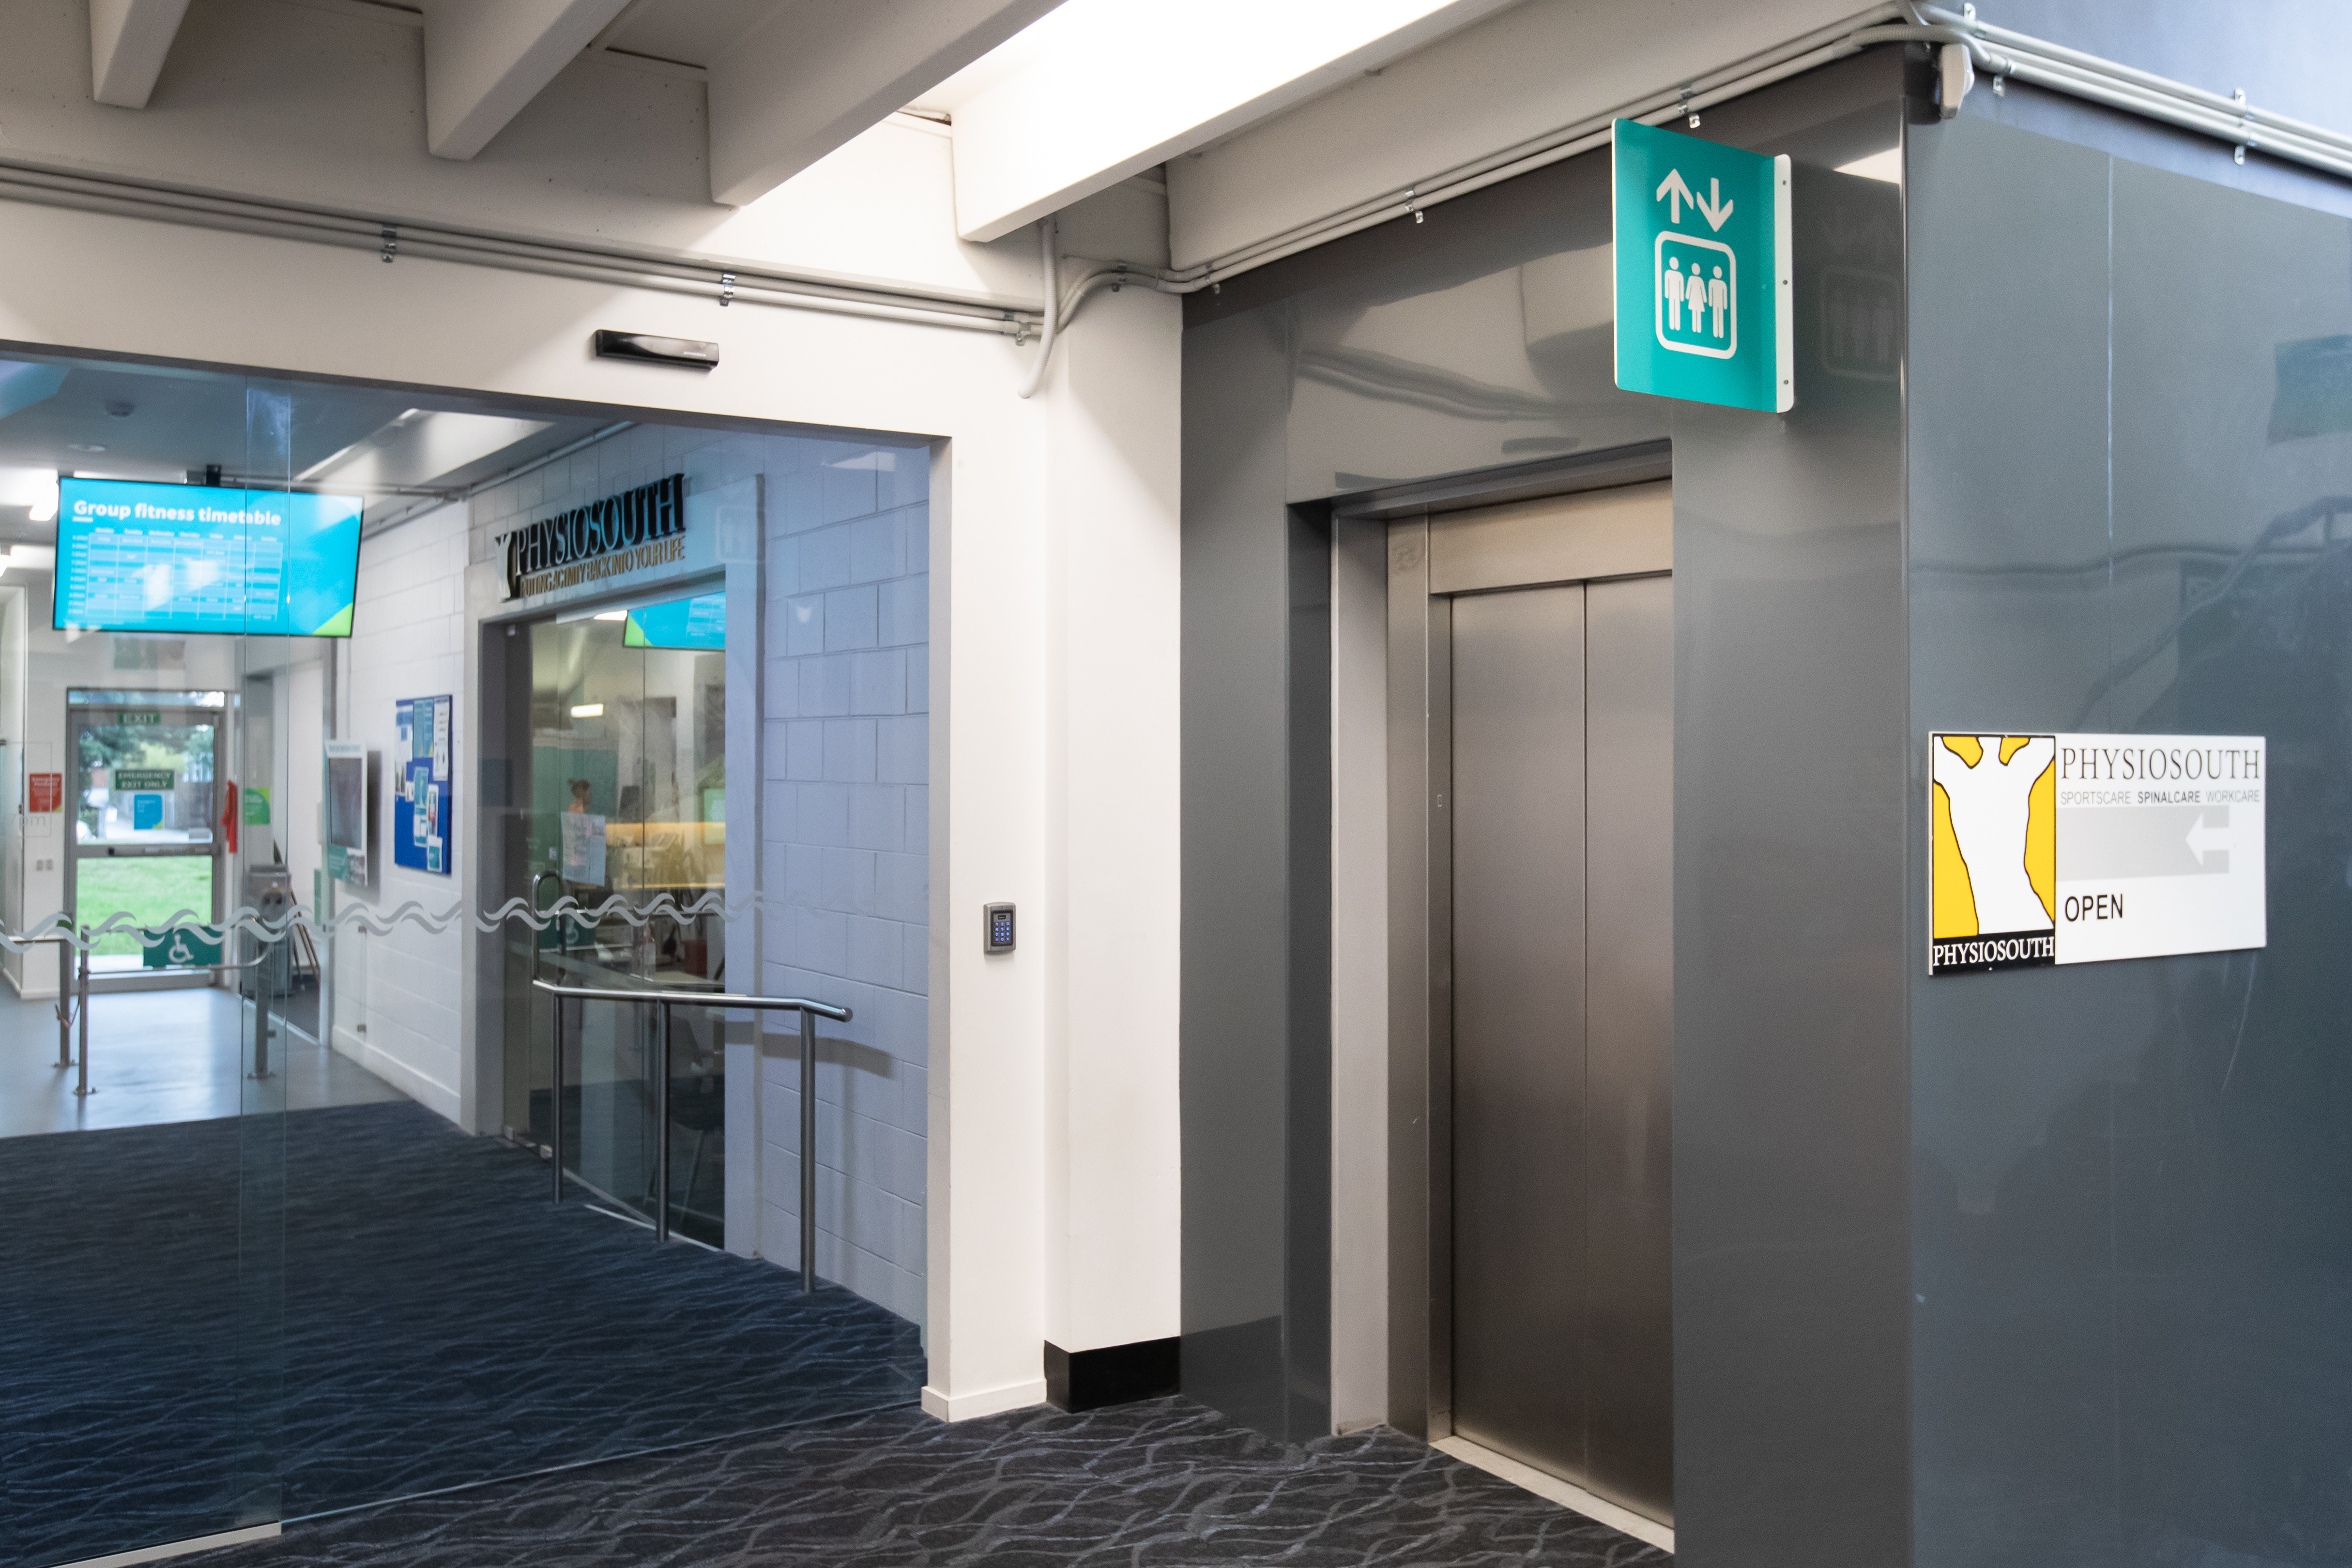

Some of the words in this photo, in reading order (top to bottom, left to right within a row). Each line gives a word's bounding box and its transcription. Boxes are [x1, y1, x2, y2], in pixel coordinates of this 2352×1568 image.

[74, 500, 131, 520] Group
[135, 502, 195, 522] fitness
[198, 507, 281, 526] timetable
[516, 473, 685, 576] PHYSIOSOUTH
[587, 556, 611, 581] BACK
[612, 549, 633, 575] INTO
[635, 543, 662, 569] YOUR
[664, 535, 686, 563] LIFE
[123, 712, 156, 723] EXIT
[2061, 747, 2260, 780] PHYSIOSOUTH
[2061, 791, 2131, 805] SPORTSCARE
[2138, 791, 2200, 804] SPINALCARE
[2206, 790, 2260, 803] WORKCARE
[2064, 894, 2124, 923] OPEN
[1933, 936, 2055, 967] PHYSIOSOUTH
